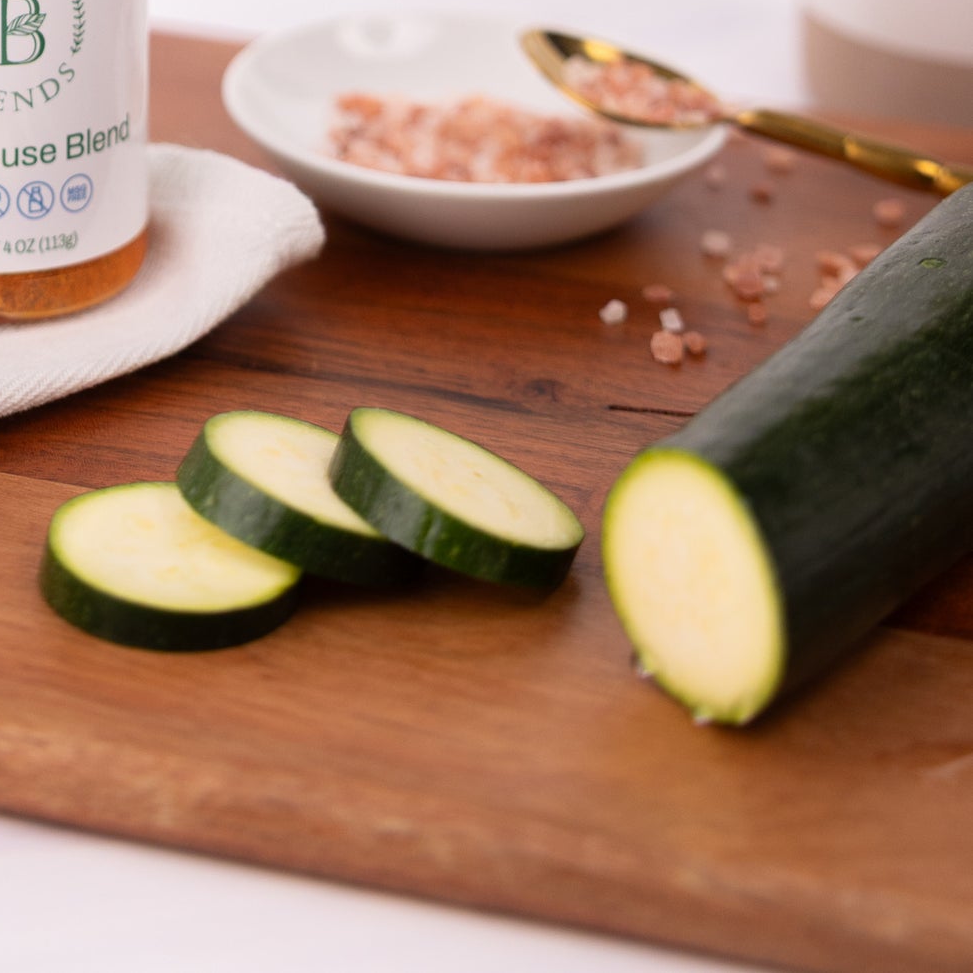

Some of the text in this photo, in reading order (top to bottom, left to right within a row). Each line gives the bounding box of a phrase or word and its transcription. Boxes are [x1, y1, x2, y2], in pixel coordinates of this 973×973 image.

[66, 114, 130, 160] Blend
[3, 240, 12, 254] 4
[15, 237, 36, 254] OZ
[38, 231, 79, 253] (113g)
